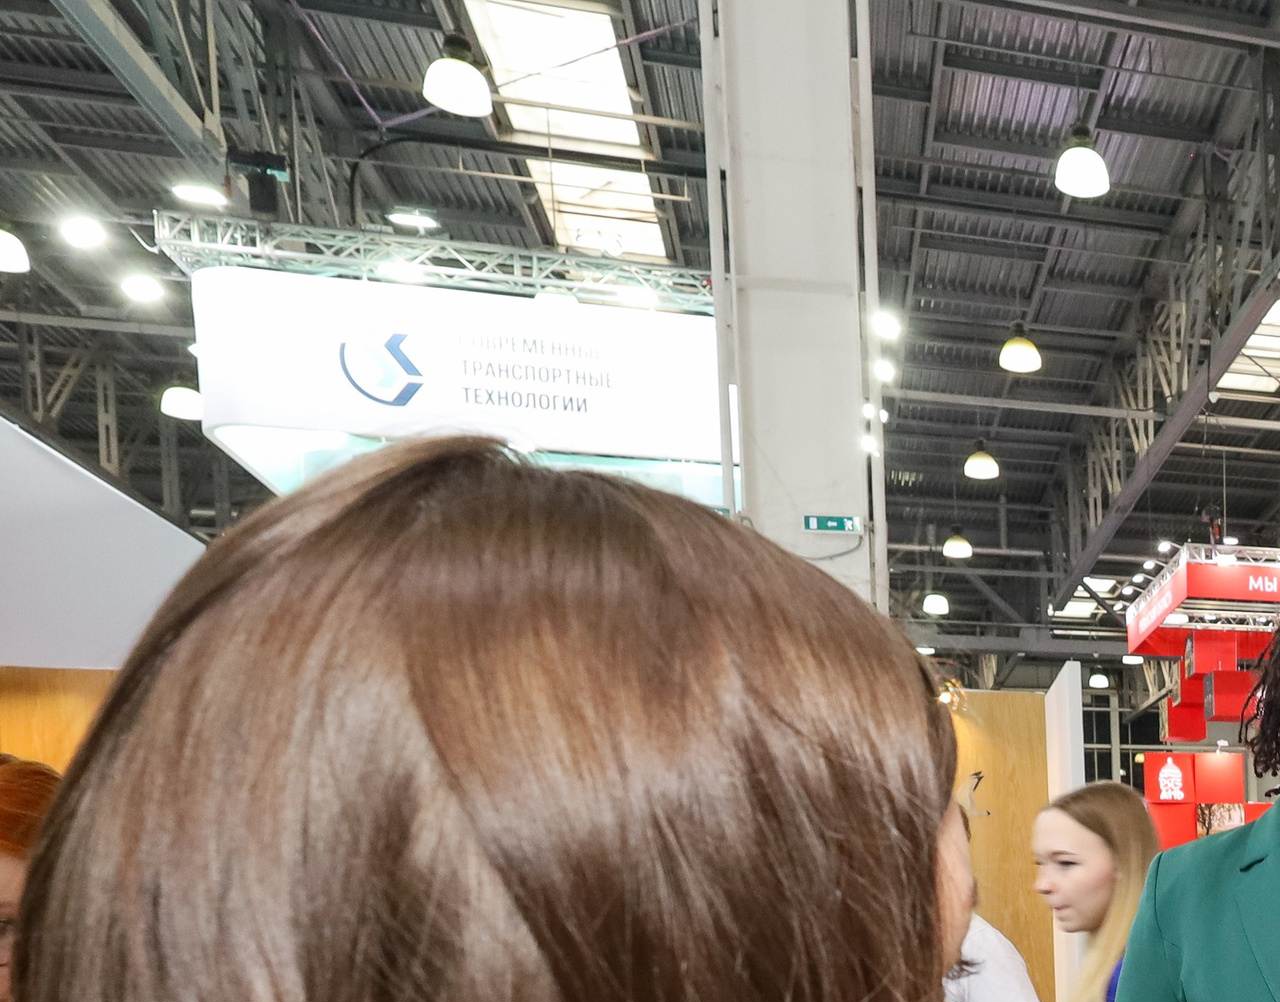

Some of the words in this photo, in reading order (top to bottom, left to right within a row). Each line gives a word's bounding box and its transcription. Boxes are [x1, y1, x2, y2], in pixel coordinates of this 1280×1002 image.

[457, 335, 600, 360] ОВРЕМЕННЫЕ
[462, 359, 613, 389] ТРАНСПОРТНЫЕ
[462, 386, 588, 413] ТЕХНОЛОГИИ
[1249, 575, 1278, 593] МЫ
